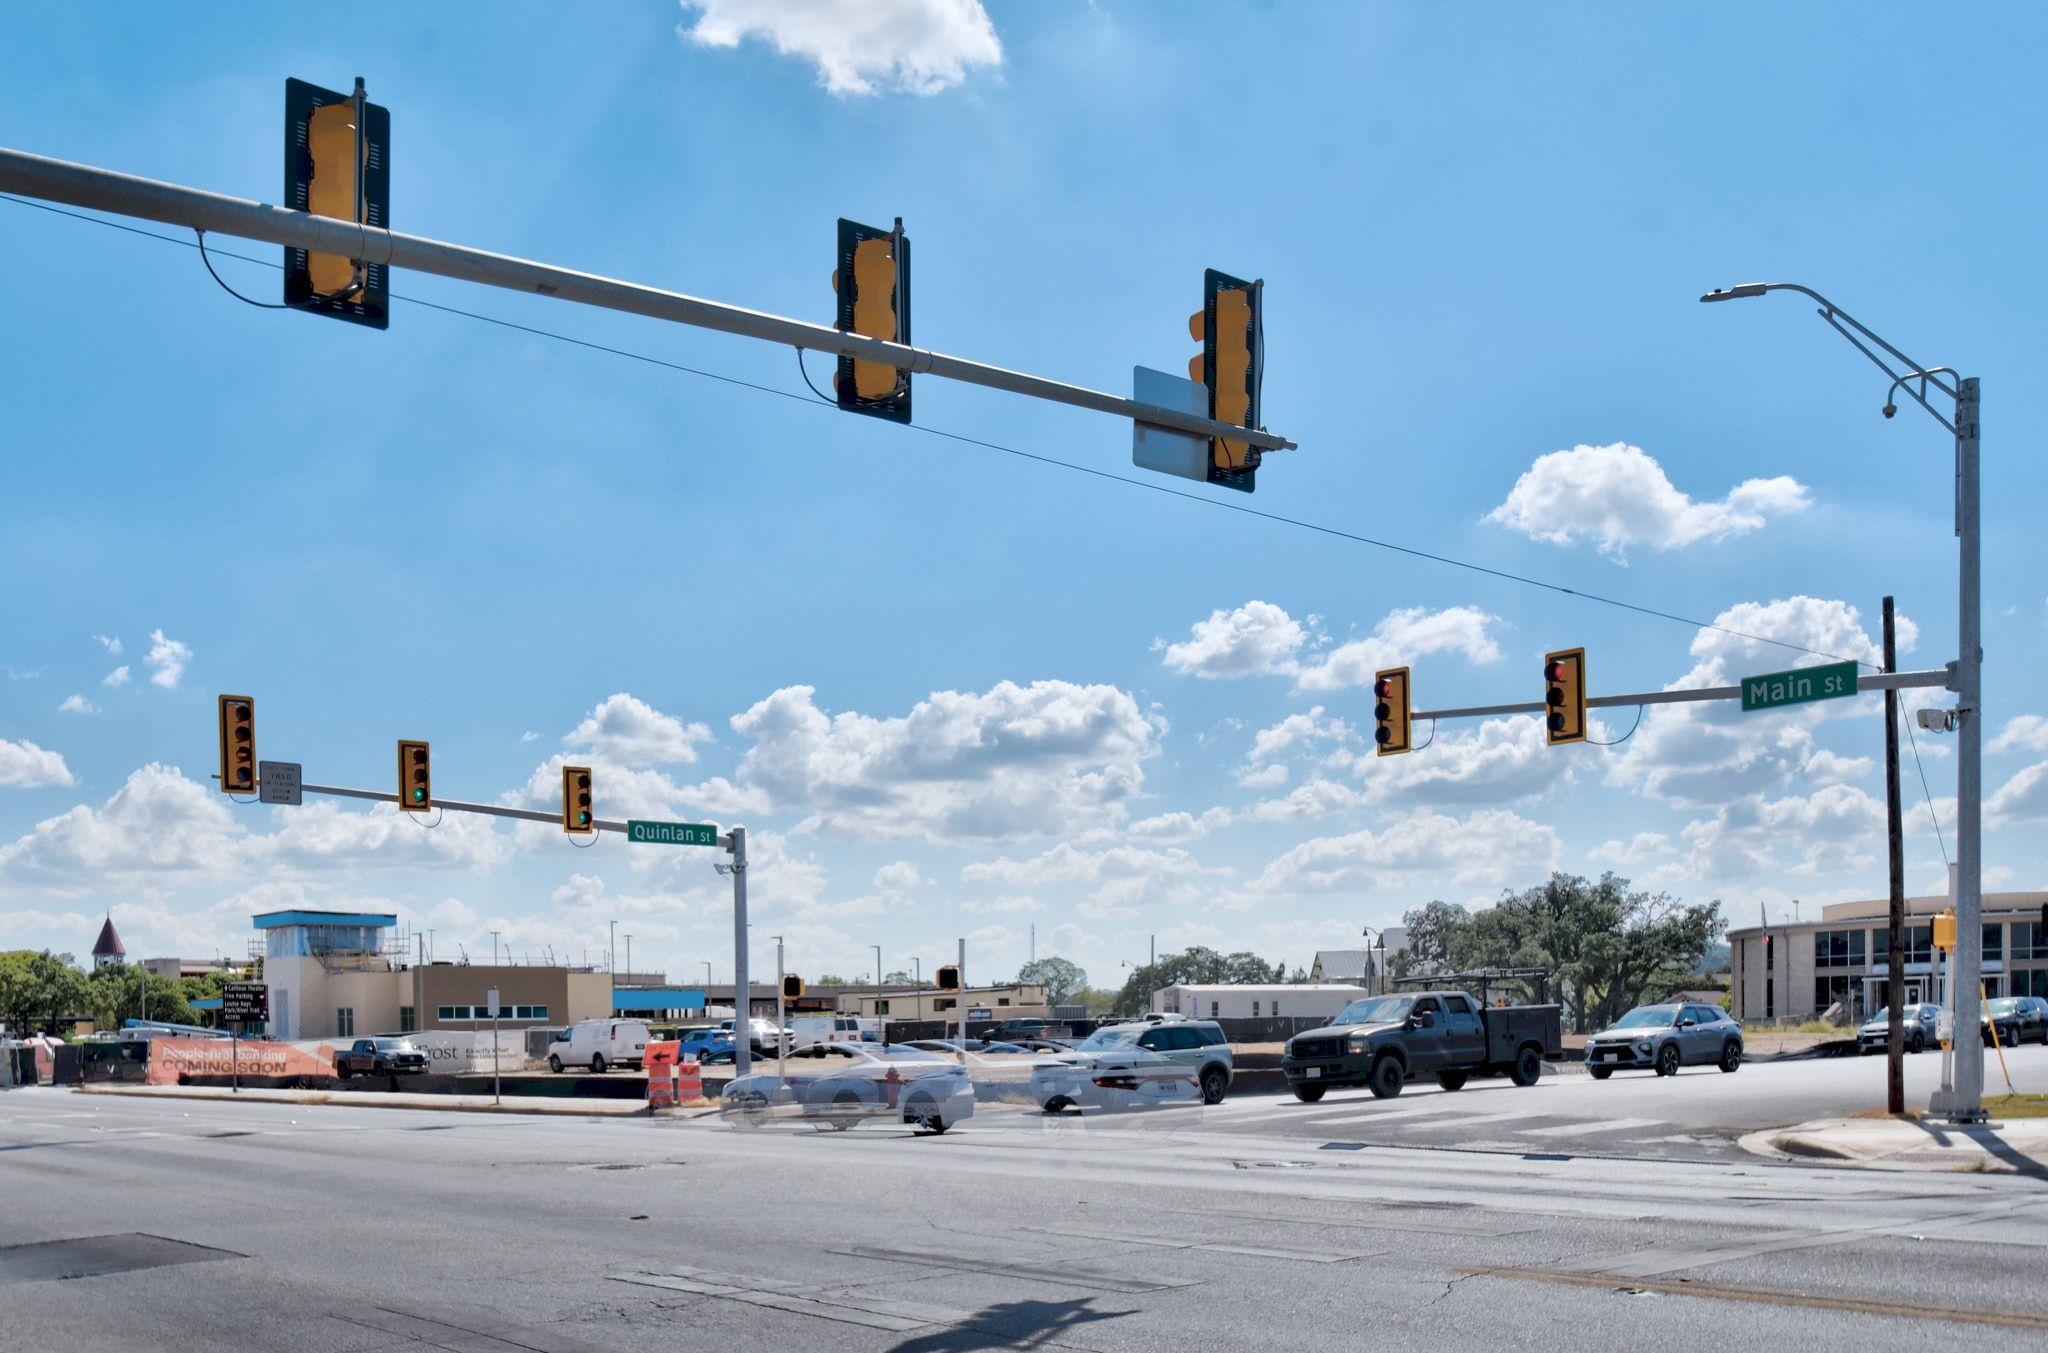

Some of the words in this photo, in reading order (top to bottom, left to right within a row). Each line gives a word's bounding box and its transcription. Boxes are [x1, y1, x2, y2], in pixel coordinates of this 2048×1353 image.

[1750, 675, 1812, 704] Main
[1824, 675, 1843, 693] St
[634, 824, 694, 841] Quinlan
[700, 831, 711, 842] St
[236, 992, 253, 1000] Parking
[162, 1059, 233, 1073] COMING
[237, 1061, 287, 1073] SOON
